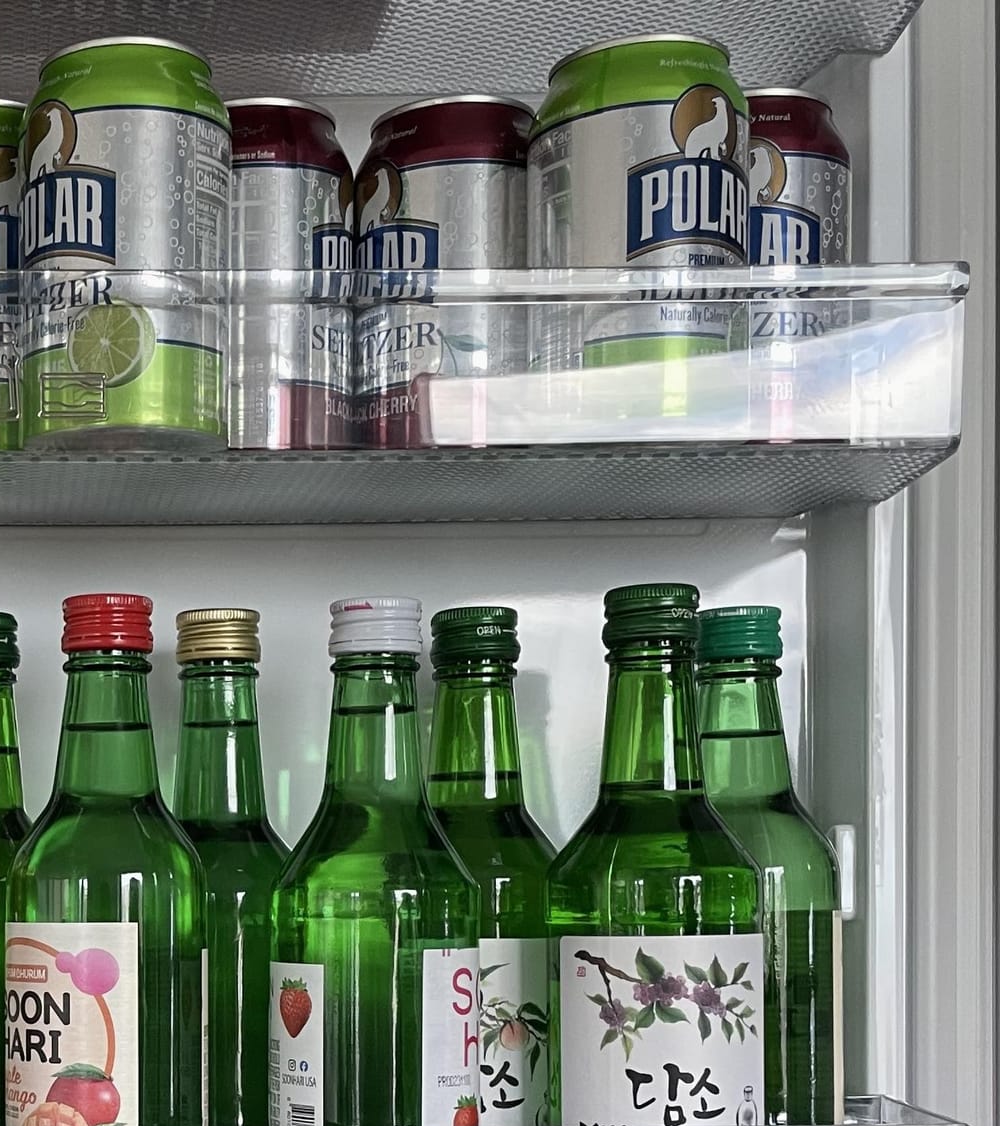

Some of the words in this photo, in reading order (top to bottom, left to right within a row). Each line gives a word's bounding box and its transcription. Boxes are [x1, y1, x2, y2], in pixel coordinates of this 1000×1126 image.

[660, 305, 703, 327] Naturally
[475, 626, 501, 639] OPEN
[6, 990, 71, 1027] OON
